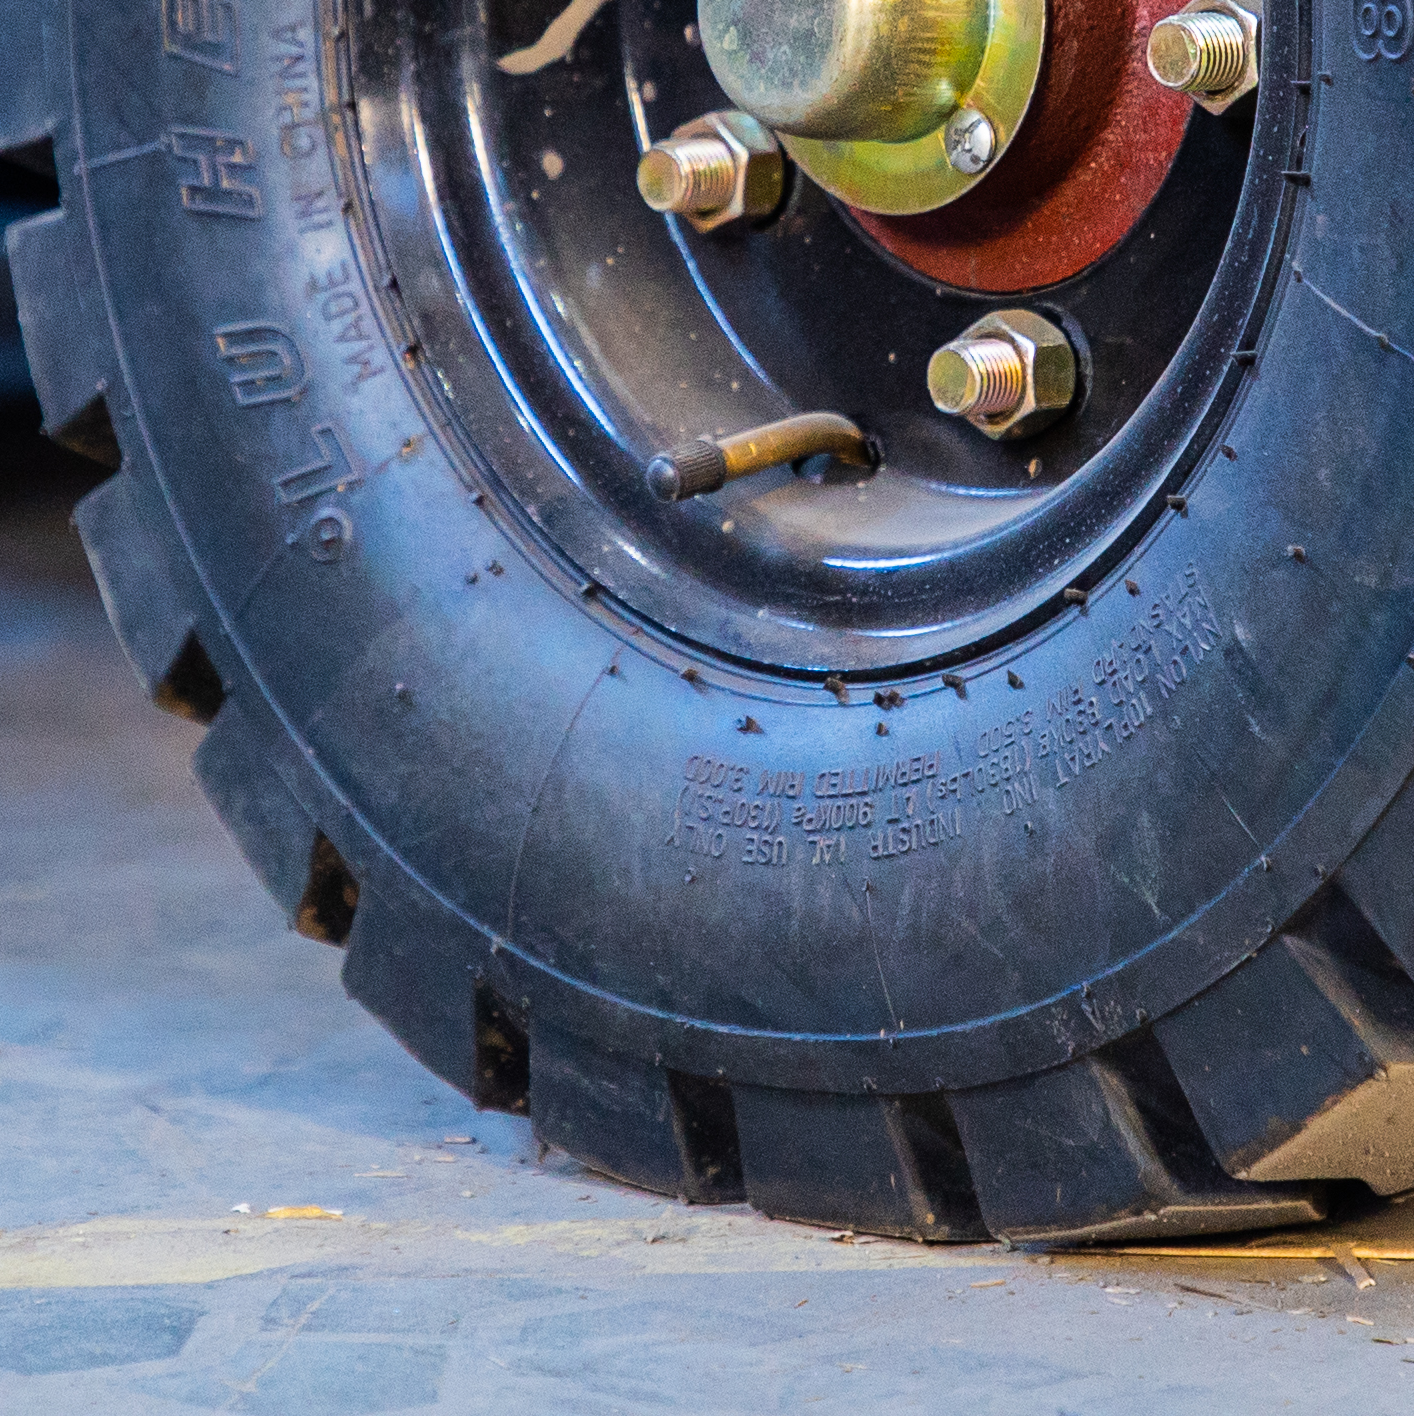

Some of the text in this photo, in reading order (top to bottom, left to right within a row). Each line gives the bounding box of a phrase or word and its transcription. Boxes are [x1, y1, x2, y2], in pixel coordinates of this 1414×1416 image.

[268, 22, 387, 391] MADE IN CHINA
[1106, 640, 1162, 707] LOAD
[664, 820, 728, 861] ONLY
[741, 833, 788, 867] USE
